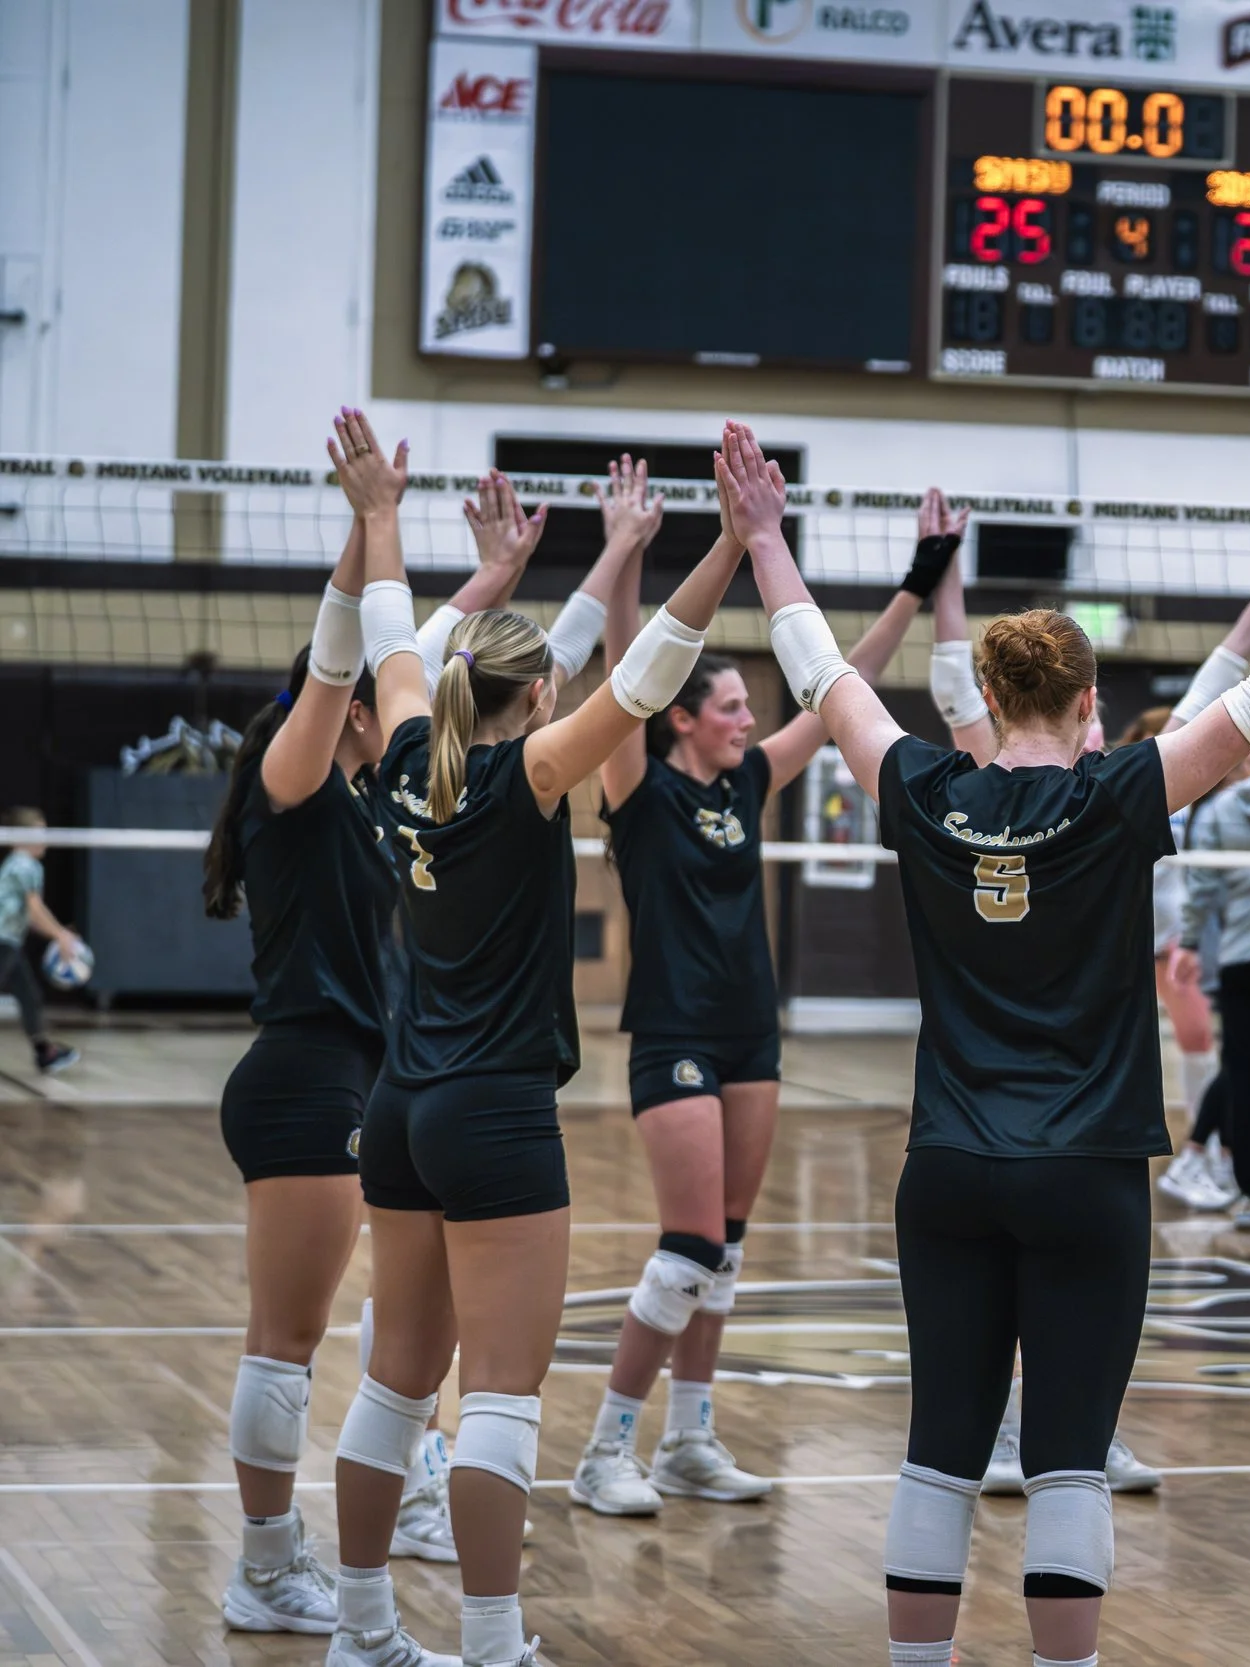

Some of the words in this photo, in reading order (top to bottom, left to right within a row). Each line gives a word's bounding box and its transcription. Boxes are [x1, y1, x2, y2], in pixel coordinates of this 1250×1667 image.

[953, 0, 1122, 58] Avera
[440, 70, 533, 111] ACE
[1046, 86, 1184, 157] 00.0
[1097, 181, 1170, 208] PERIOD
[971, 197, 1050, 263] 25
[1115, 216, 1149, 259] 4
[944, 264, 1009, 292] FOULS
[1061, 270, 1113, 297] FOUL
[1124, 273, 1201, 300] PLAYER
[942, 348, 1006, 376] SCORE
[1093, 355, 1165, 381] MATCH
[96, 462, 191, 480] MUSTANG
[197, 466, 312, 485] VOLLEYBALL
[1093, 502, 1179, 520] MUSTANG
[970, 852, 1031, 922] 5
